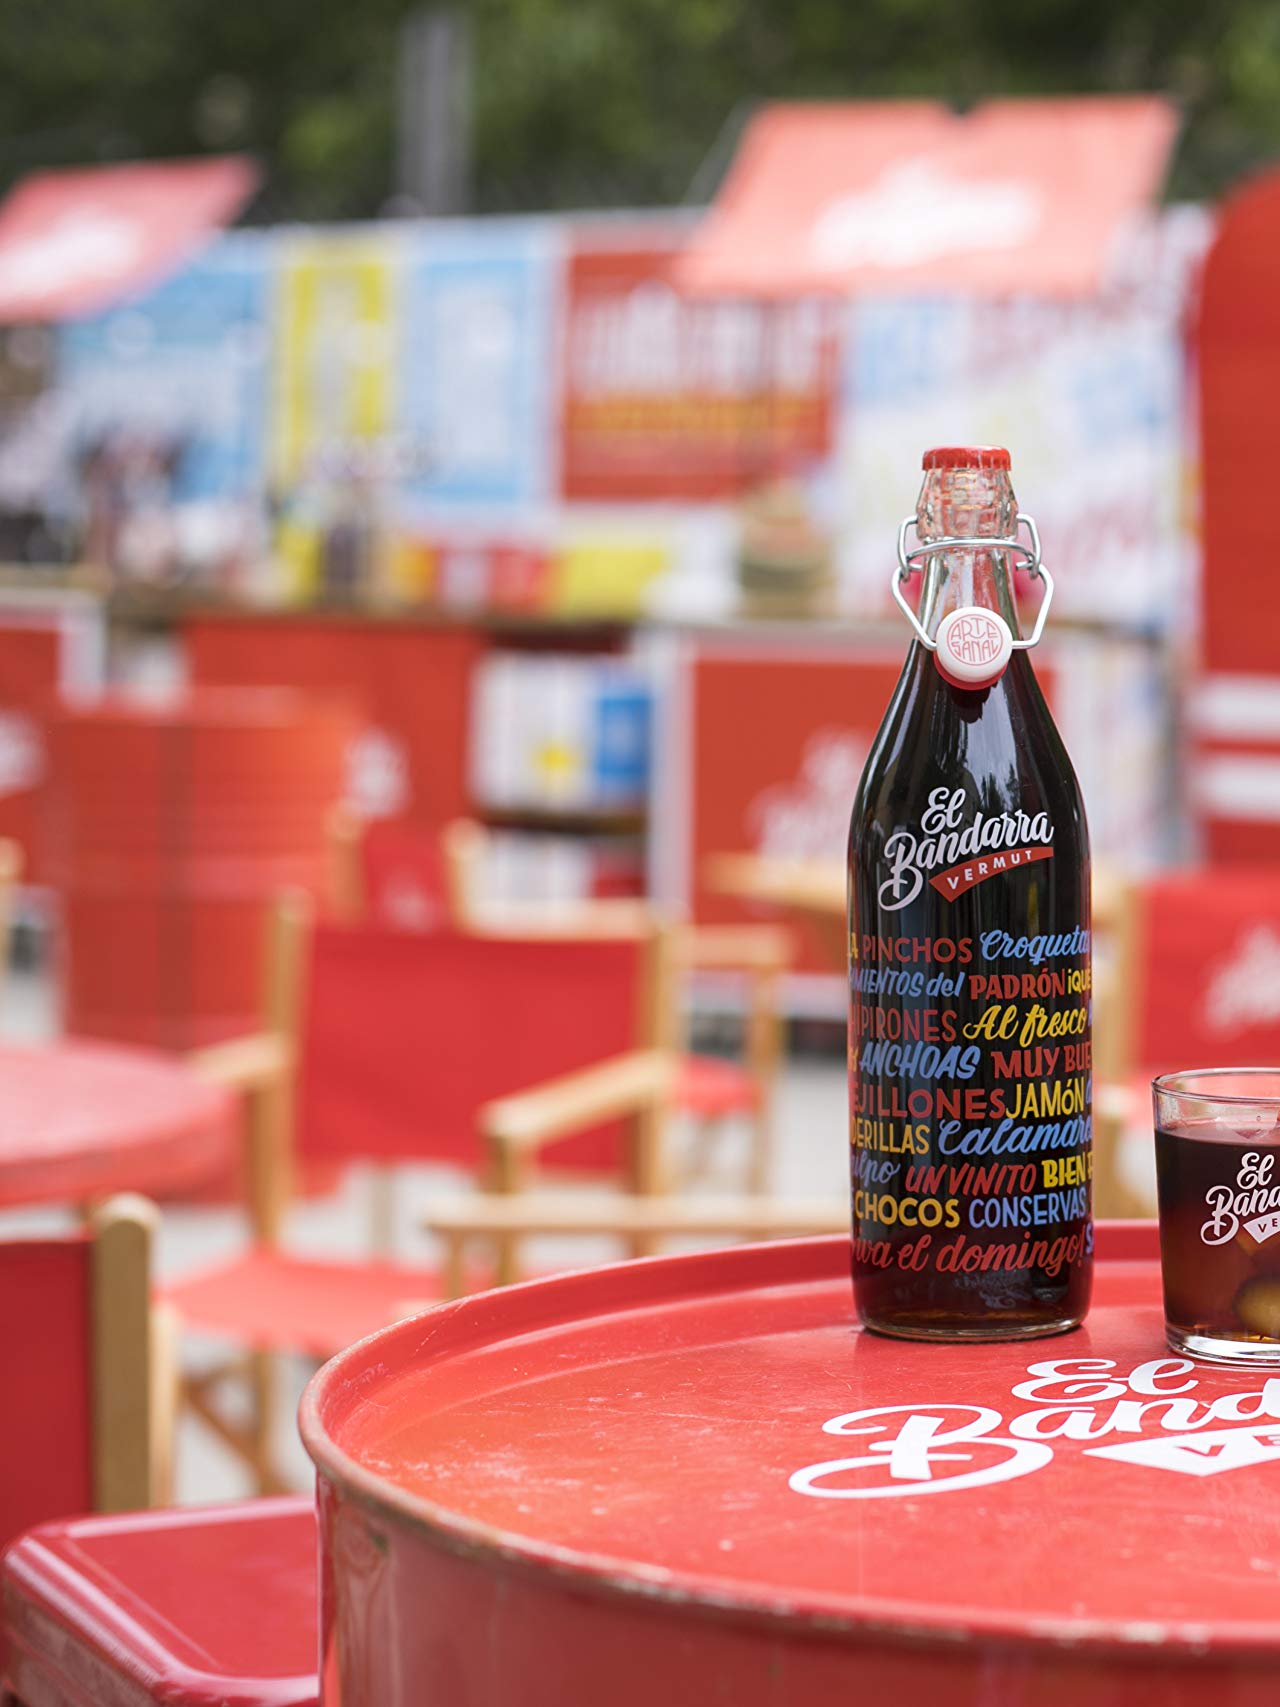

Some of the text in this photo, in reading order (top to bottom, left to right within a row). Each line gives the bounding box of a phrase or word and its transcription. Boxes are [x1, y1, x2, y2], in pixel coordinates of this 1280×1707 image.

[951, 617, 999, 640] ARTE
[951, 639, 999, 662] SANAL
[921, 786, 967, 835] El
[878, 808, 1055, 911] Bandarra
[946, 849, 1033, 890] VERMUT
[862, 935, 973, 964] PINCHOS
[925, 971, 966, 998] del
[969, 967, 1066, 1000] PADRÓN
[962, 1004, 1019, 1041] Al
[1019, 1003, 1088, 1048] fresco
[859, 1039, 981, 1080] ANCHOAS
[991, 1046, 1060, 1079] MUY
[1005, 1076, 1085, 1119] JAMÓN
[905, 1164, 948, 1195] UN
[948, 1162, 1037, 1197] VINITO
[1041, 1151, 1086, 1188] BIEN
[1236, 1151, 1275, 1189] El
[855, 1186, 1087, 1229] CHOCOS CONSERVAS
[897, 1234, 931, 1272] el
[935, 1230, 1086, 1277] domingo!
[1011, 1358, 1200, 1403] El
